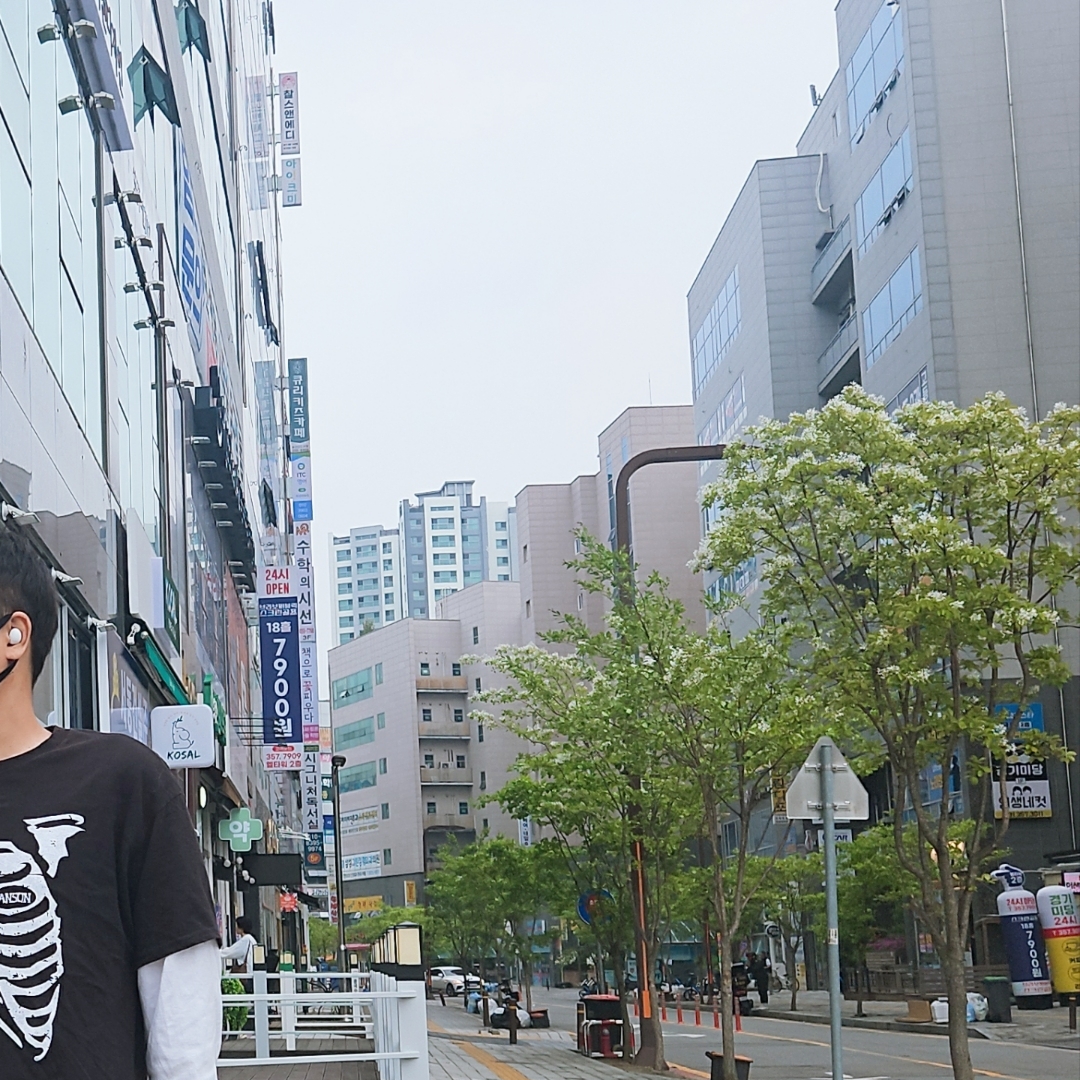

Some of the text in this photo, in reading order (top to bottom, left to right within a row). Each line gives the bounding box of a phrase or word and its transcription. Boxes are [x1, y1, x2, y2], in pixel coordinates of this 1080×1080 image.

[265, 568, 289, 581] 24시
[266, 582, 289, 595] OPEN
[167, 750, 201, 761] KOSAL
[229, 820, 251, 843] 약
